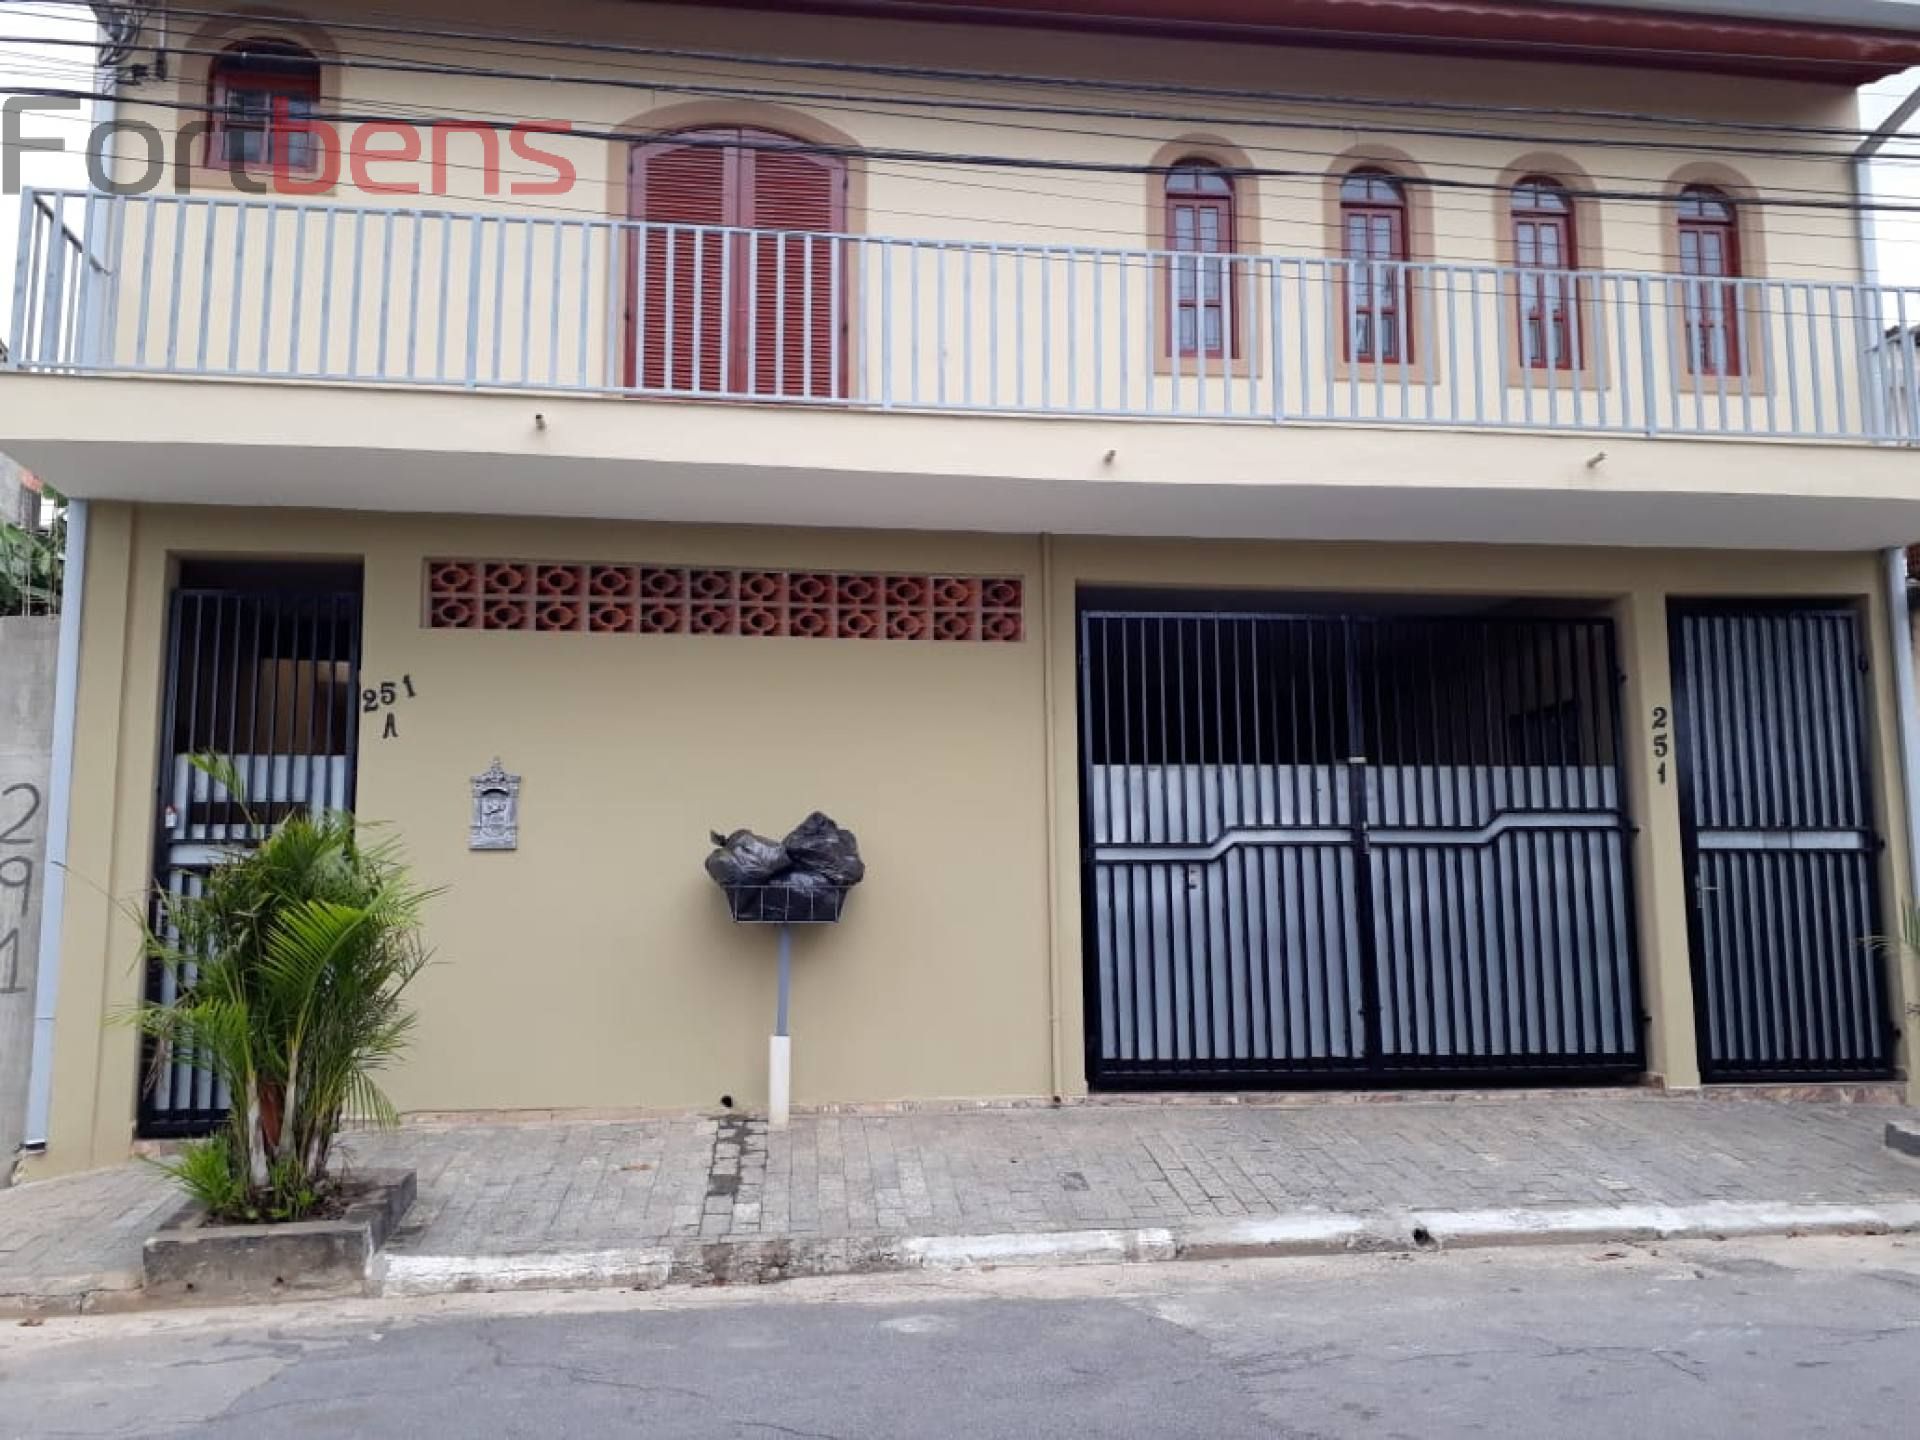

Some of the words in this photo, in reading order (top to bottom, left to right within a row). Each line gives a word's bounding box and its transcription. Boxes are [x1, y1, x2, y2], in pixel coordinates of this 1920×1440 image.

[362, 674, 416, 712] 251
[382, 712, 398, 739] A
[1652, 706, 1667, 784] 251
[0, 782, 41, 994] 291
